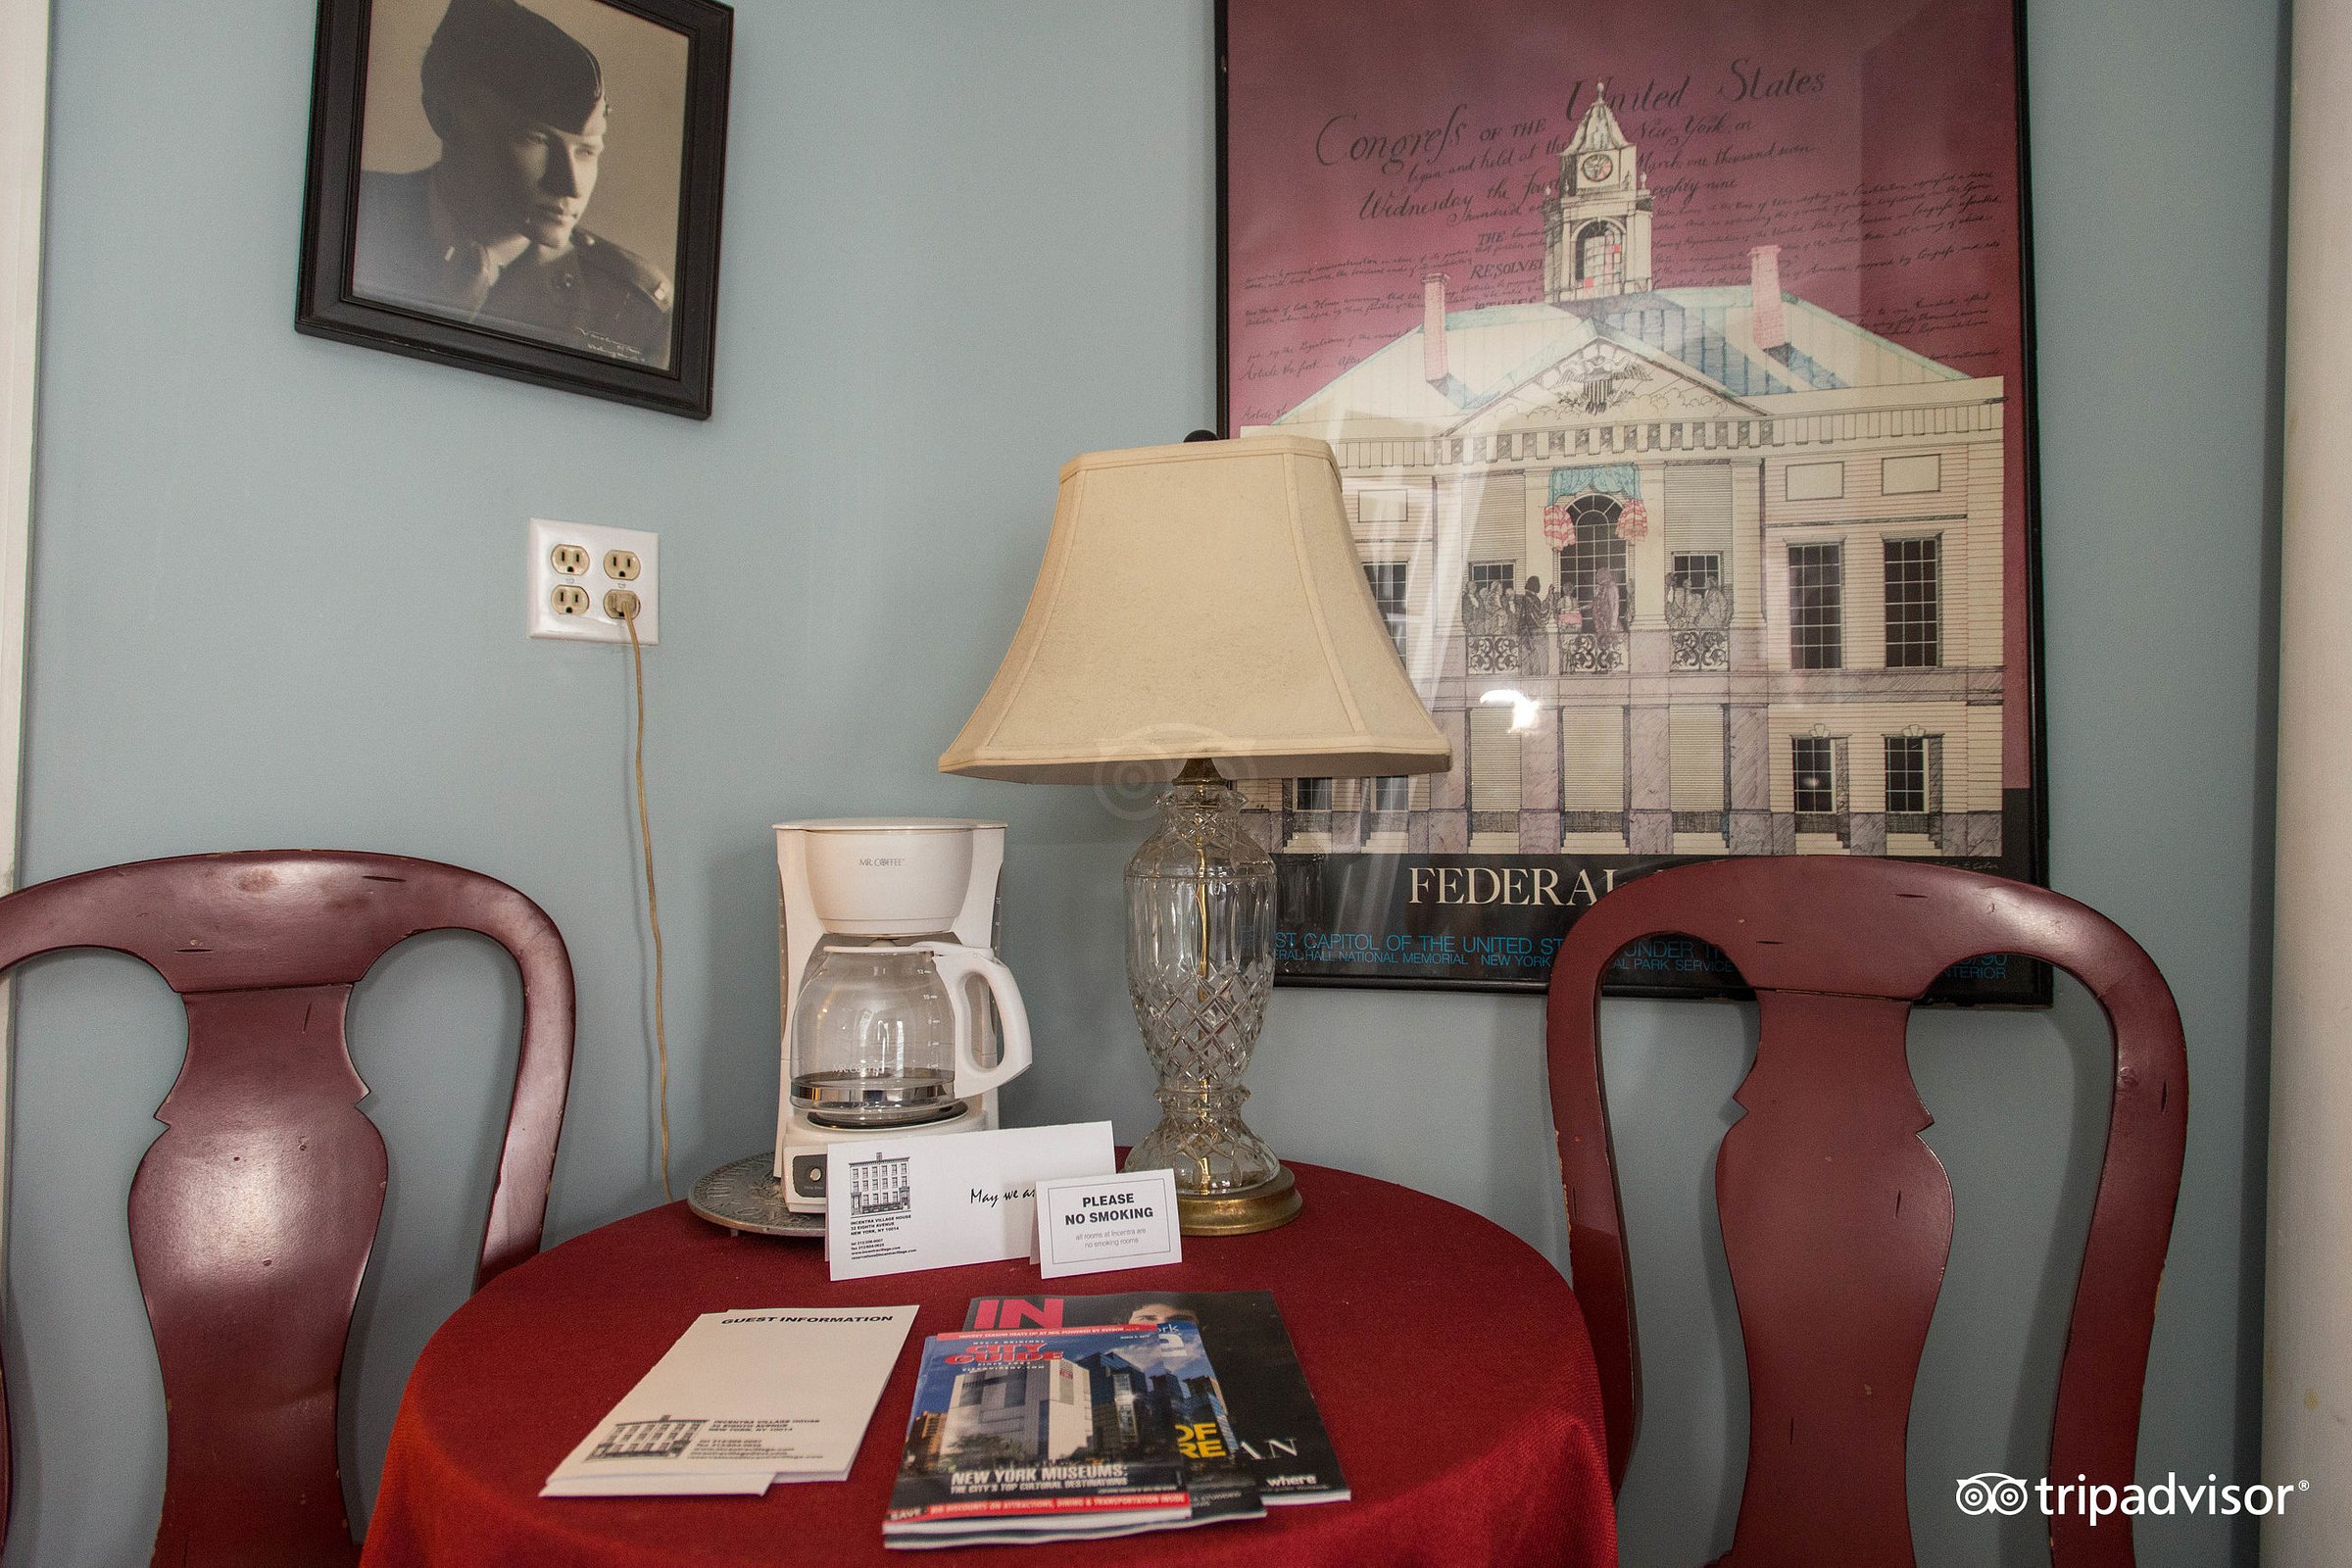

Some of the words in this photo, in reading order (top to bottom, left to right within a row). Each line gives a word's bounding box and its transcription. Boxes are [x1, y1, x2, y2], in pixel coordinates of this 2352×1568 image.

[1717, 58, 1826, 103] States
[1303, 933, 1381, 951] CAPITOL
[1386, 935, 1412, 951] OF
[1418, 935, 1455, 953] THE
[1462, 936, 1534, 955] UNITED
[1305, 949, 1336, 961] HALL
[1339, 951, 1398, 963] NATIONAL
[1402, 953, 1469, 965] MEMORIAL
[1481, 954, 1510, 966] NEW
[1515, 955, 1551, 967] YORK
[1634, 958, 1668, 971] PARK
[970, 1188, 999, 1207] May
[1004, 1190, 1018, 1201] we
[1082, 1193, 1135, 1207] PLEASE
[1064, 1213, 1086, 1225] NO
[1089, 1206, 1153, 1225] SMOKING
[1084, 1231, 1103, 1241] rooms
[1110, 1227, 1136, 1238] Incentra
[1093, 1238, 1120, 1250] smoking
[1119, 1236, 1139, 1245] rooms
[973, 1298, 1064, 1329] IN
[965, 1342, 1047, 1354] CITY
[945, 1350, 1064, 1365] GUIDE
[951, 1470, 991, 1485] NEW
[994, 1468, 1036, 1484] YORK
[1041, 1464, 1128, 1481] MUSEUMS:
[1265, 1474, 1318, 1487] where
[950, 1485, 966, 1494] THE
[1001, 1483, 1019, 1492] TOP
